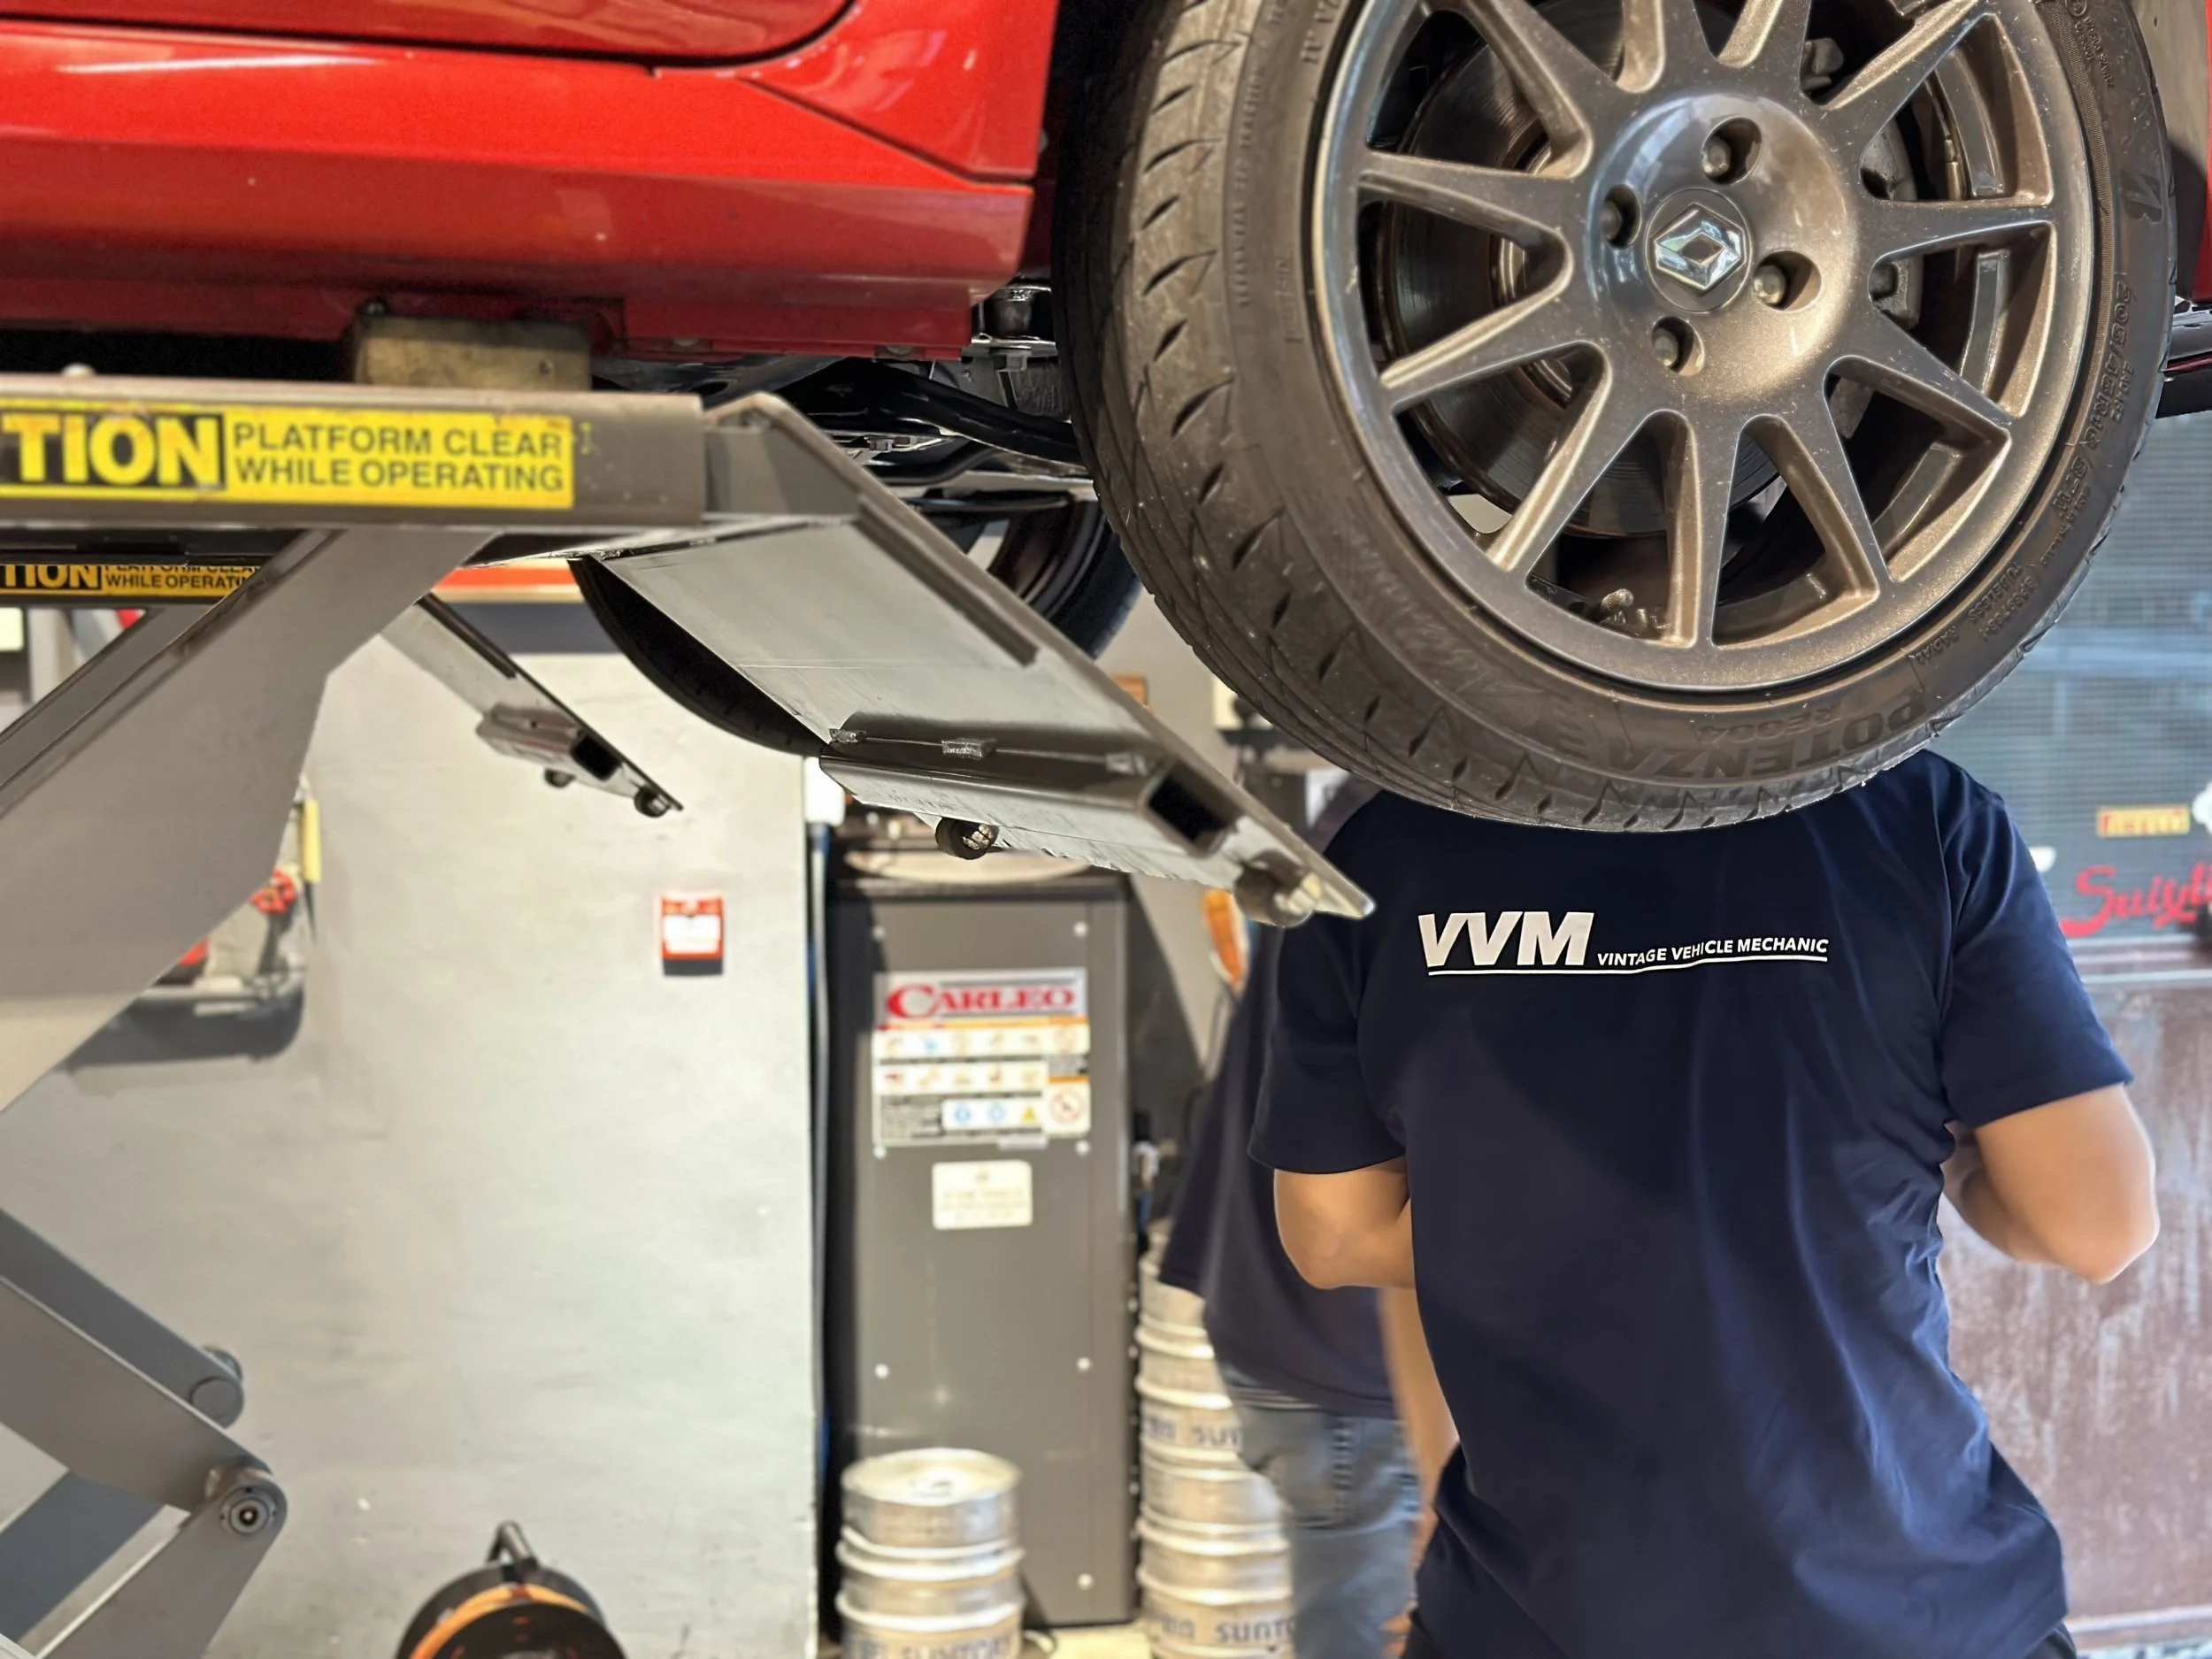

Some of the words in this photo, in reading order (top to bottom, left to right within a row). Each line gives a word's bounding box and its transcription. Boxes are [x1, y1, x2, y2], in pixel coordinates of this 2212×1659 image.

[2, 413, 220, 486] TION
[234, 423, 432, 453] PLATFORM
[443, 429, 563, 459] CLEAR
[235, 457, 352, 486] WHILE
[359, 460, 564, 492] OPERATING
[106, 575, 162, 588] WHILE
[1608, 688, 1926, 779] POTENZA
[1418, 911, 1594, 967] VVM
[1597, 947, 1667, 966] VINTAGE
[1671, 941, 1733, 961] VEHICLE
[1737, 937, 1829, 954] MECHANIC
